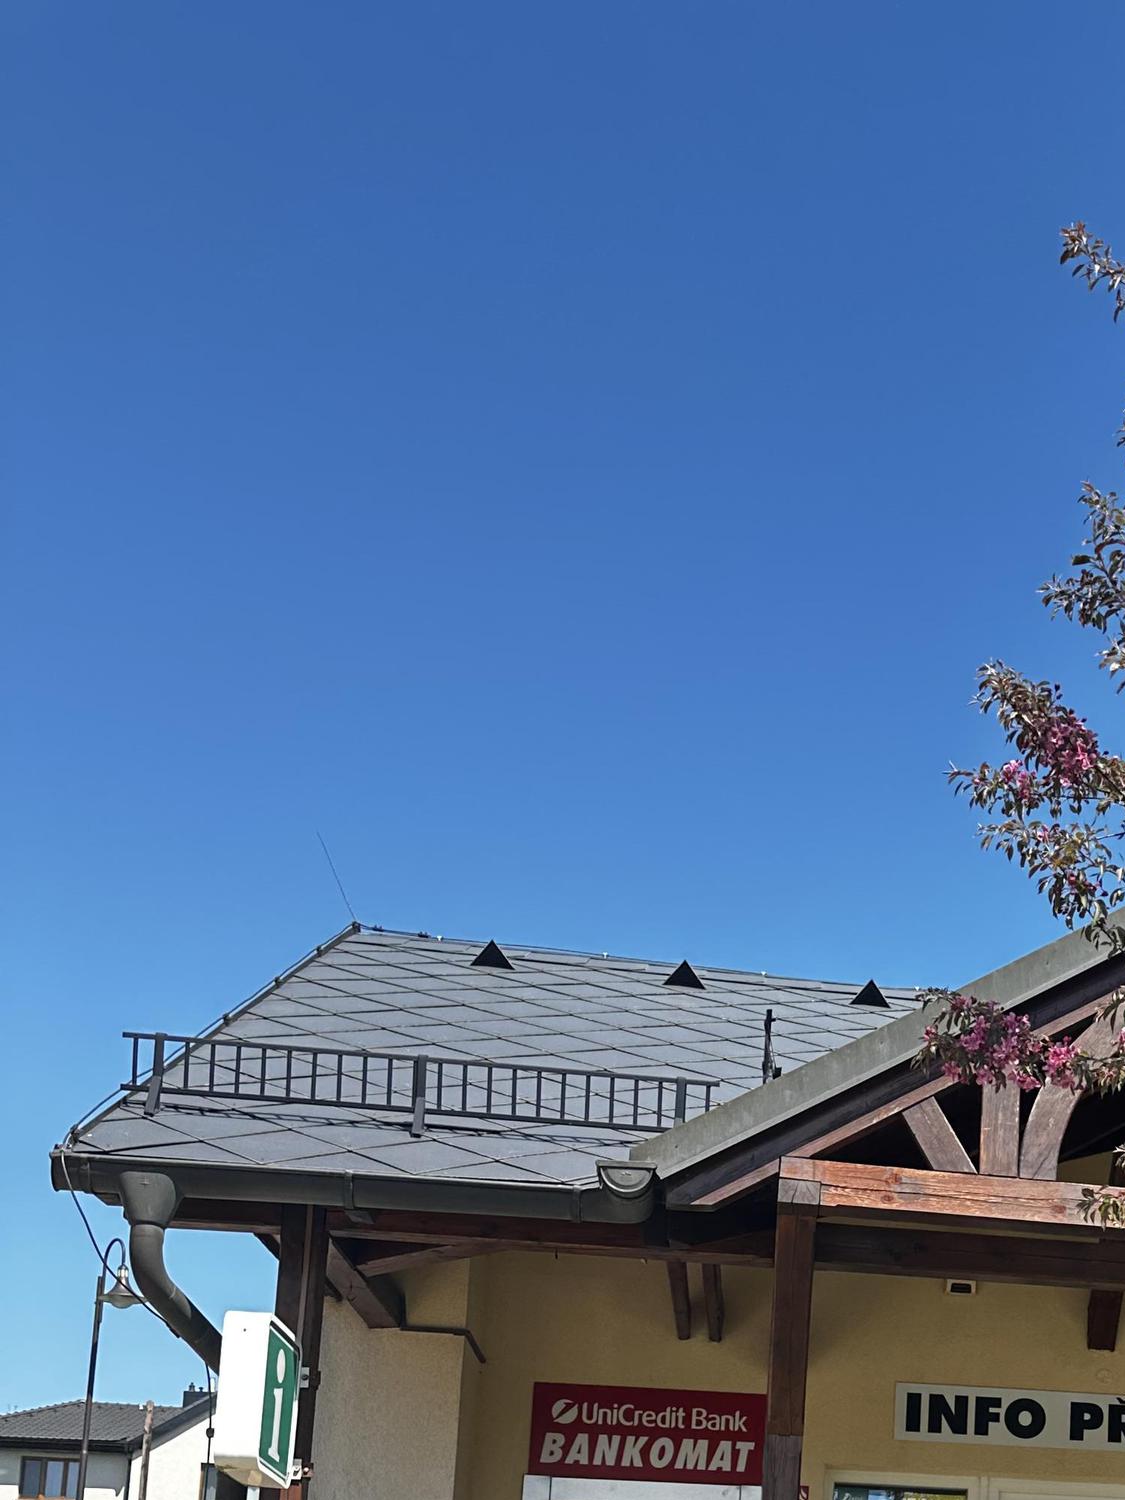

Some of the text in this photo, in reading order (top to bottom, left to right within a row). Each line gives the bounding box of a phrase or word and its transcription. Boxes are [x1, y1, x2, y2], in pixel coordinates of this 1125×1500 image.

[581, 1402, 748, 1433] UniCredit Bank
[905, 1392, 1047, 1439] INFO
[540, 1432, 755, 1473] BANKOMAT
